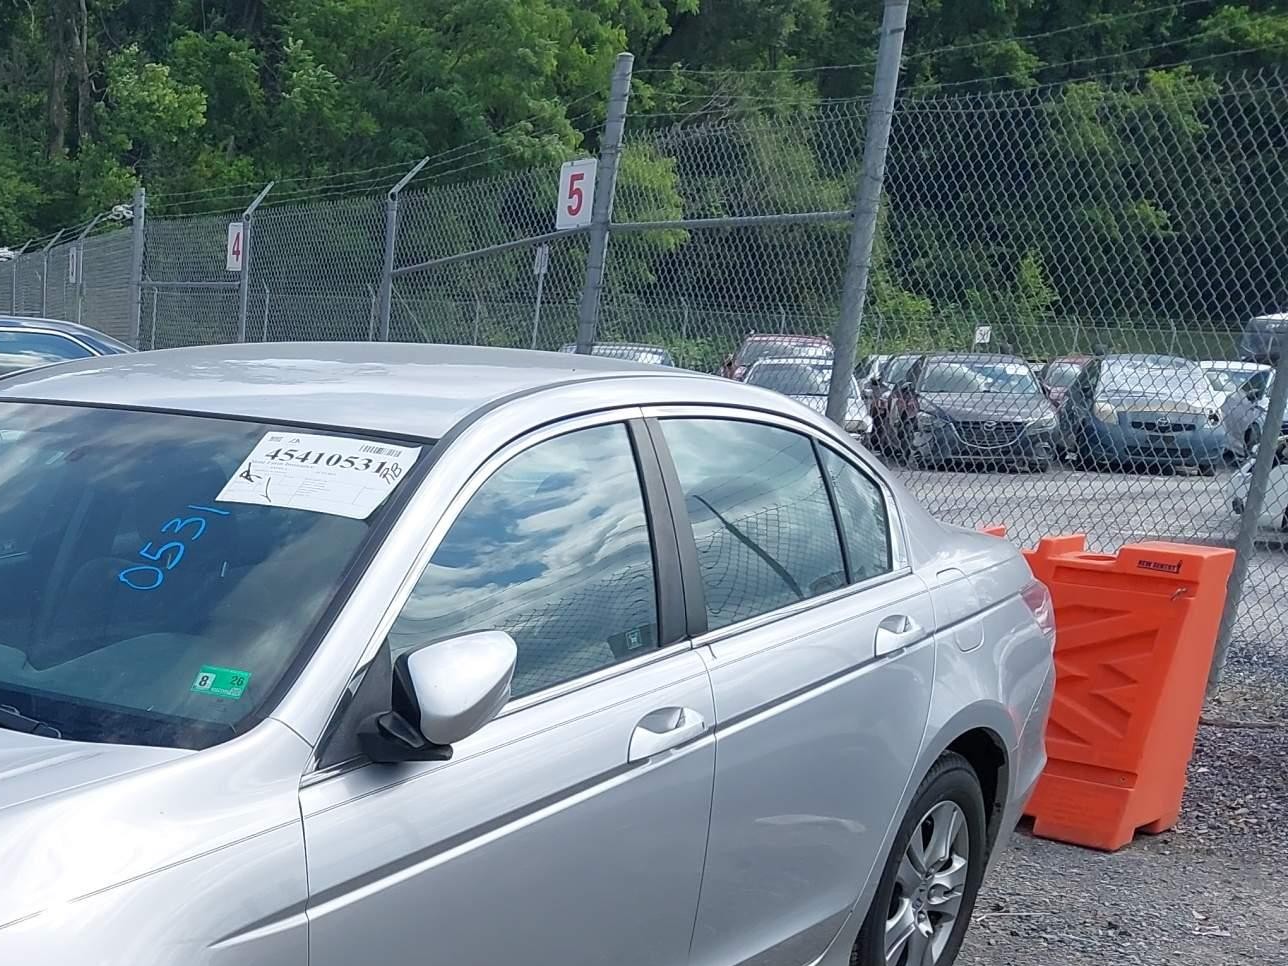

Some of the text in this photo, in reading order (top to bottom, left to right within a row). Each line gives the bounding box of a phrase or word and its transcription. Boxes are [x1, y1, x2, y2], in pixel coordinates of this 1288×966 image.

[567, 173, 584, 216] 5
[232, 231, 241, 262] 4
[265, 448, 388, 474] 45410531
[119, 504, 231, 590] 0531
[198, 675, 209, 687] 8
